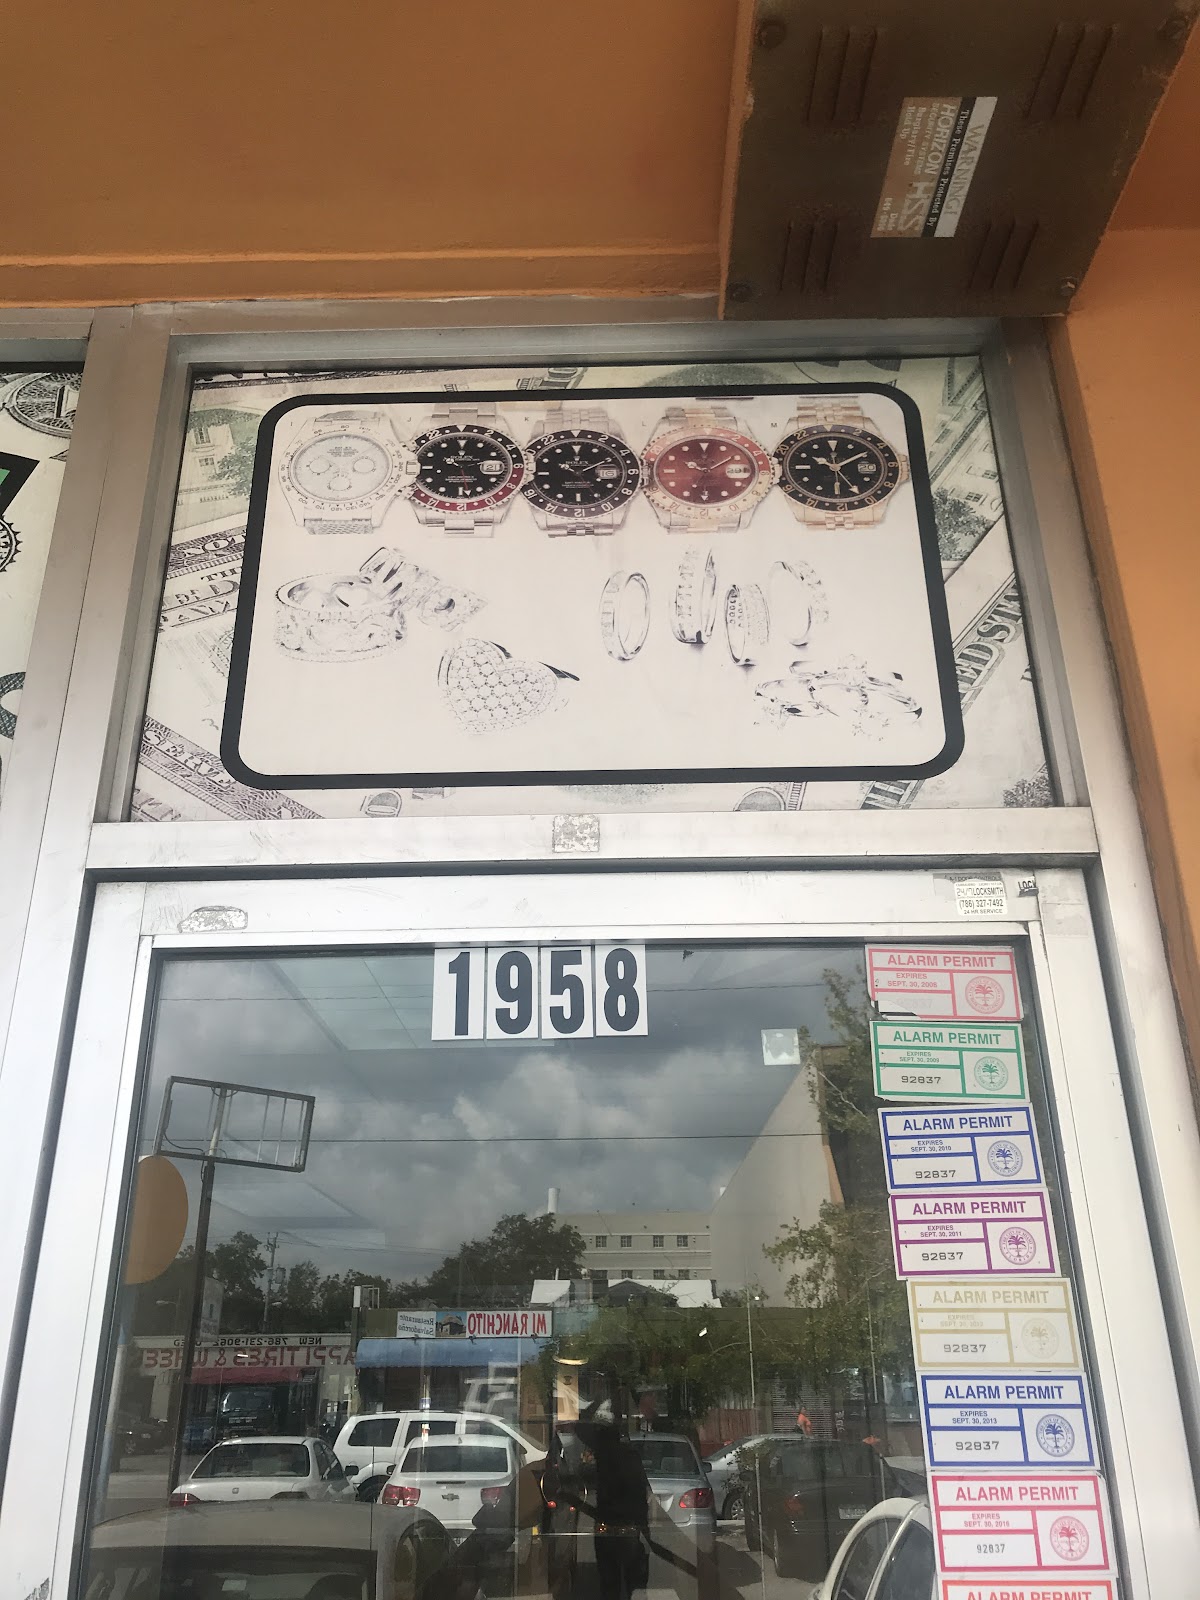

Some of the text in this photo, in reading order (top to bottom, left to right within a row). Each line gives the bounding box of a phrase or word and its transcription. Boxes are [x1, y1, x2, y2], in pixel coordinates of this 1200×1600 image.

[924, 103, 939, 139] SECURITY
[900, 128, 909, 139] Up
[897, 104, 956, 231] HORIZON HSS
[926, 109, 970, 227] These Premises Protected By
[944, 124, 985, 215] WARNING!
[426, 429, 442, 439] 22
[794, 430, 809, 439] 22
[541, 435, 557, 445] 22
[776, 445, 790, 455] 20
[524, 489, 537, 499] 16
[782, 485, 794, 493] 16
[427, 498, 439, 507] 14
[484, 497, 497, 505] 10
[806, 499, 818, 507] 14
[864, 496, 877, 505] 10
[457, 503, 467, 511] 12
[545, 503, 558, 513] 14
[601, 502, 614, 511] 10
[837, 503, 848, 511] 12
[574, 509, 585, 517] 12
[973, 887, 1004, 896] LOCKSMITH
[959, 899, 1004, 909] (786) 327-7492
[888, 954, 995, 968] ALARM PERMIT
[896, 972, 927, 980] EXPIRES
[887, 980, 907, 988] SEPT.
[449, 948, 640, 1036] 1958
[893, 1030, 1001, 1045] ALARM PERMIT
[901, 1075, 941, 1084] 92837
[903, 1116, 1012, 1131] ALARM PERMIT
[915, 1170, 956, 1179] 92837
[913, 1201, 1026, 1215] ALARM PERMIT
[921, 1252, 963, 1261] 92837
[933, 1290, 1049, 1304] ALARM PERMIT
[943, 1344, 986, 1353] 92837
[944, 1385, 1063, 1400] ALARM PERMIT
[970, 1417, 981, 1425] 30,
[955, 1441, 999, 1451] 92837
[955, 1486, 1079, 1501] ALARM PERMIT
[964, 1520, 981, 1528] SEPT.
[982, 1520, 993, 1528] 30,
[976, 1544, 1005, 1554] 92837
